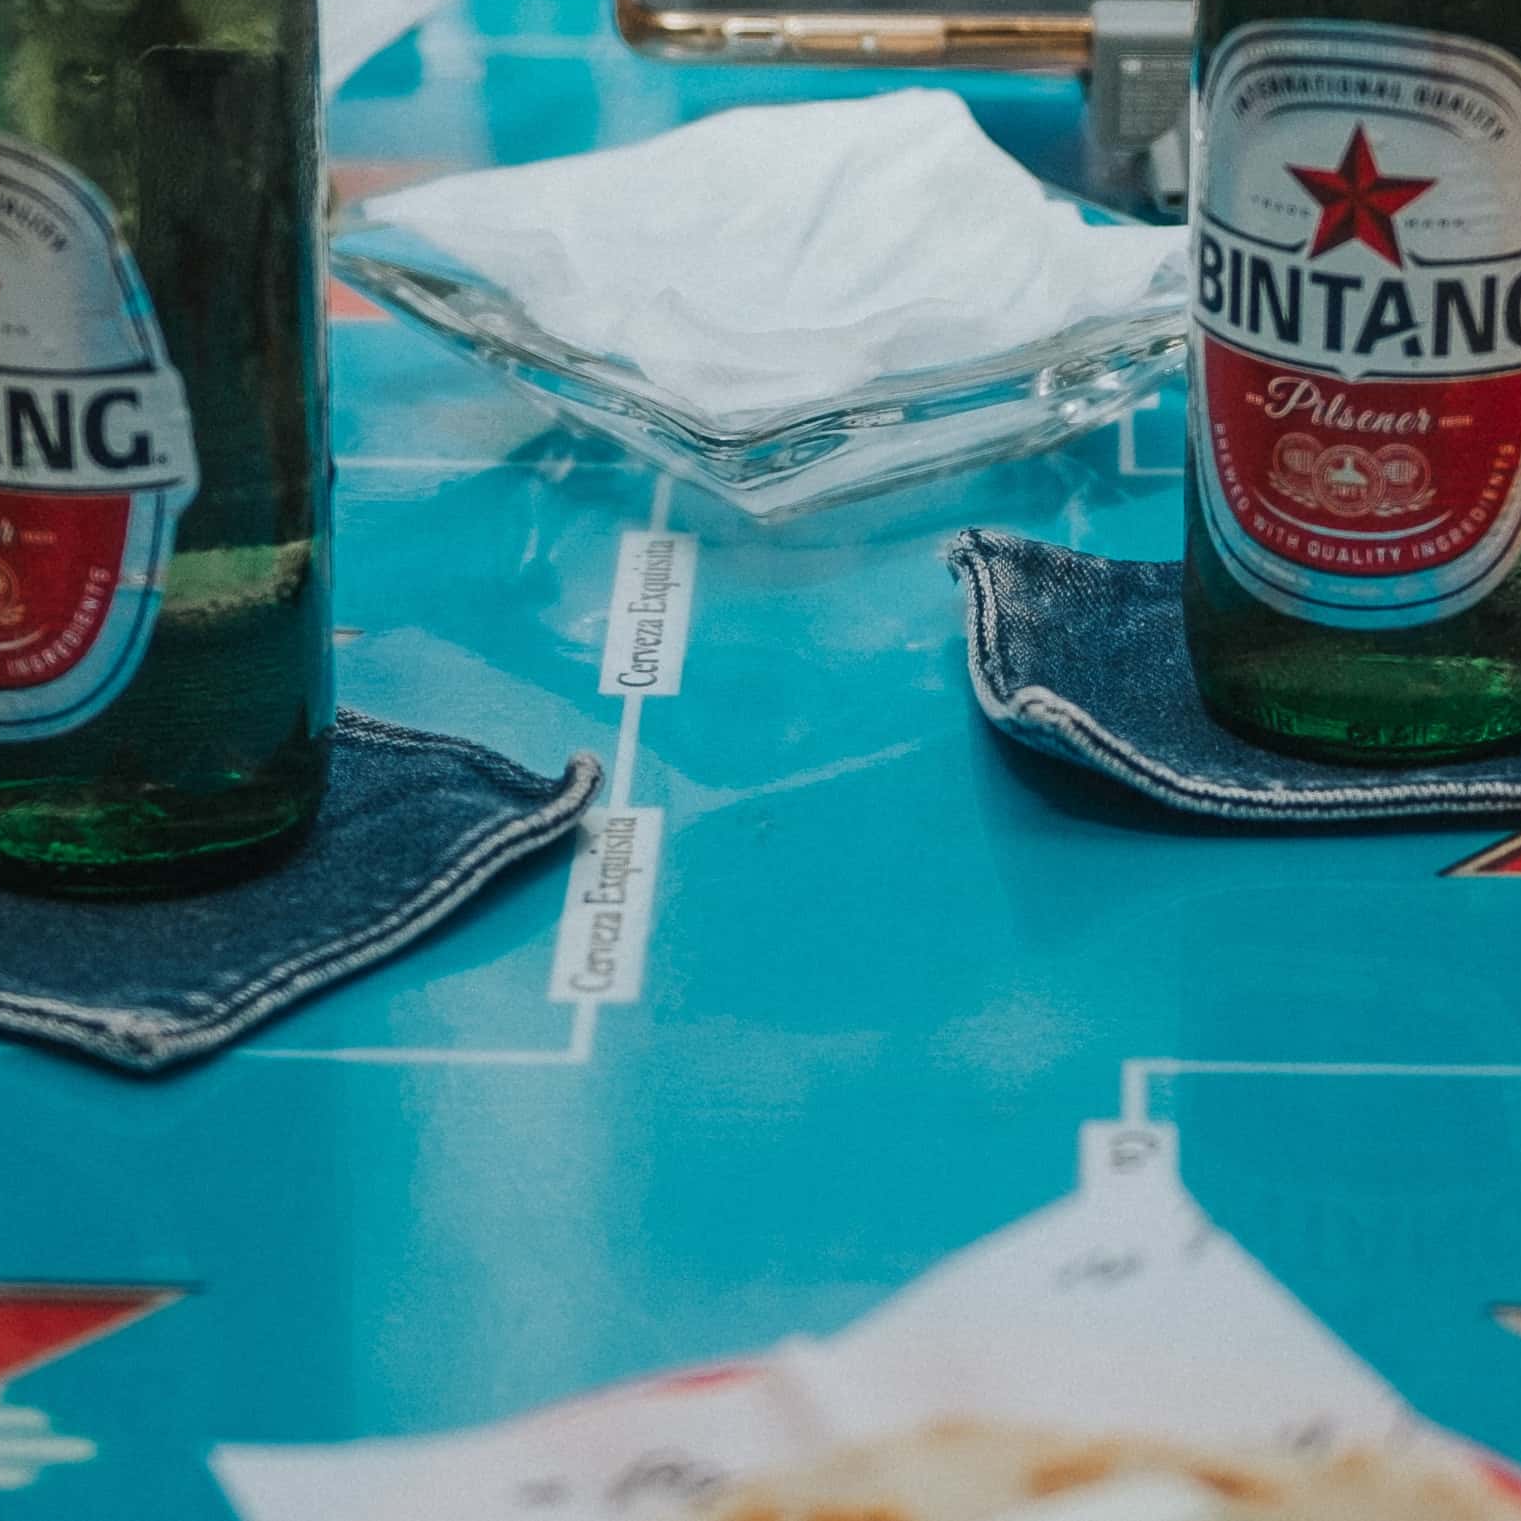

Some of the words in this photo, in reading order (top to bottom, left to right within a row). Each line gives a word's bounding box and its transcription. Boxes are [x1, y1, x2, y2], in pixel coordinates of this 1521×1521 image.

[1264, 376, 1432, 434] Pilsener
[1214, 423, 1251, 512] BREWED
[1253, 512, 1300, 550] WITH
[1307, 539, 1402, 567] QUALITY
[1412, 443, 1518, 562] INGREDIENTS
[627, 539, 681, 614] Exquisita
[616, 619, 664, 688] Cerveza
[581, 816, 643, 905] Exquisita
